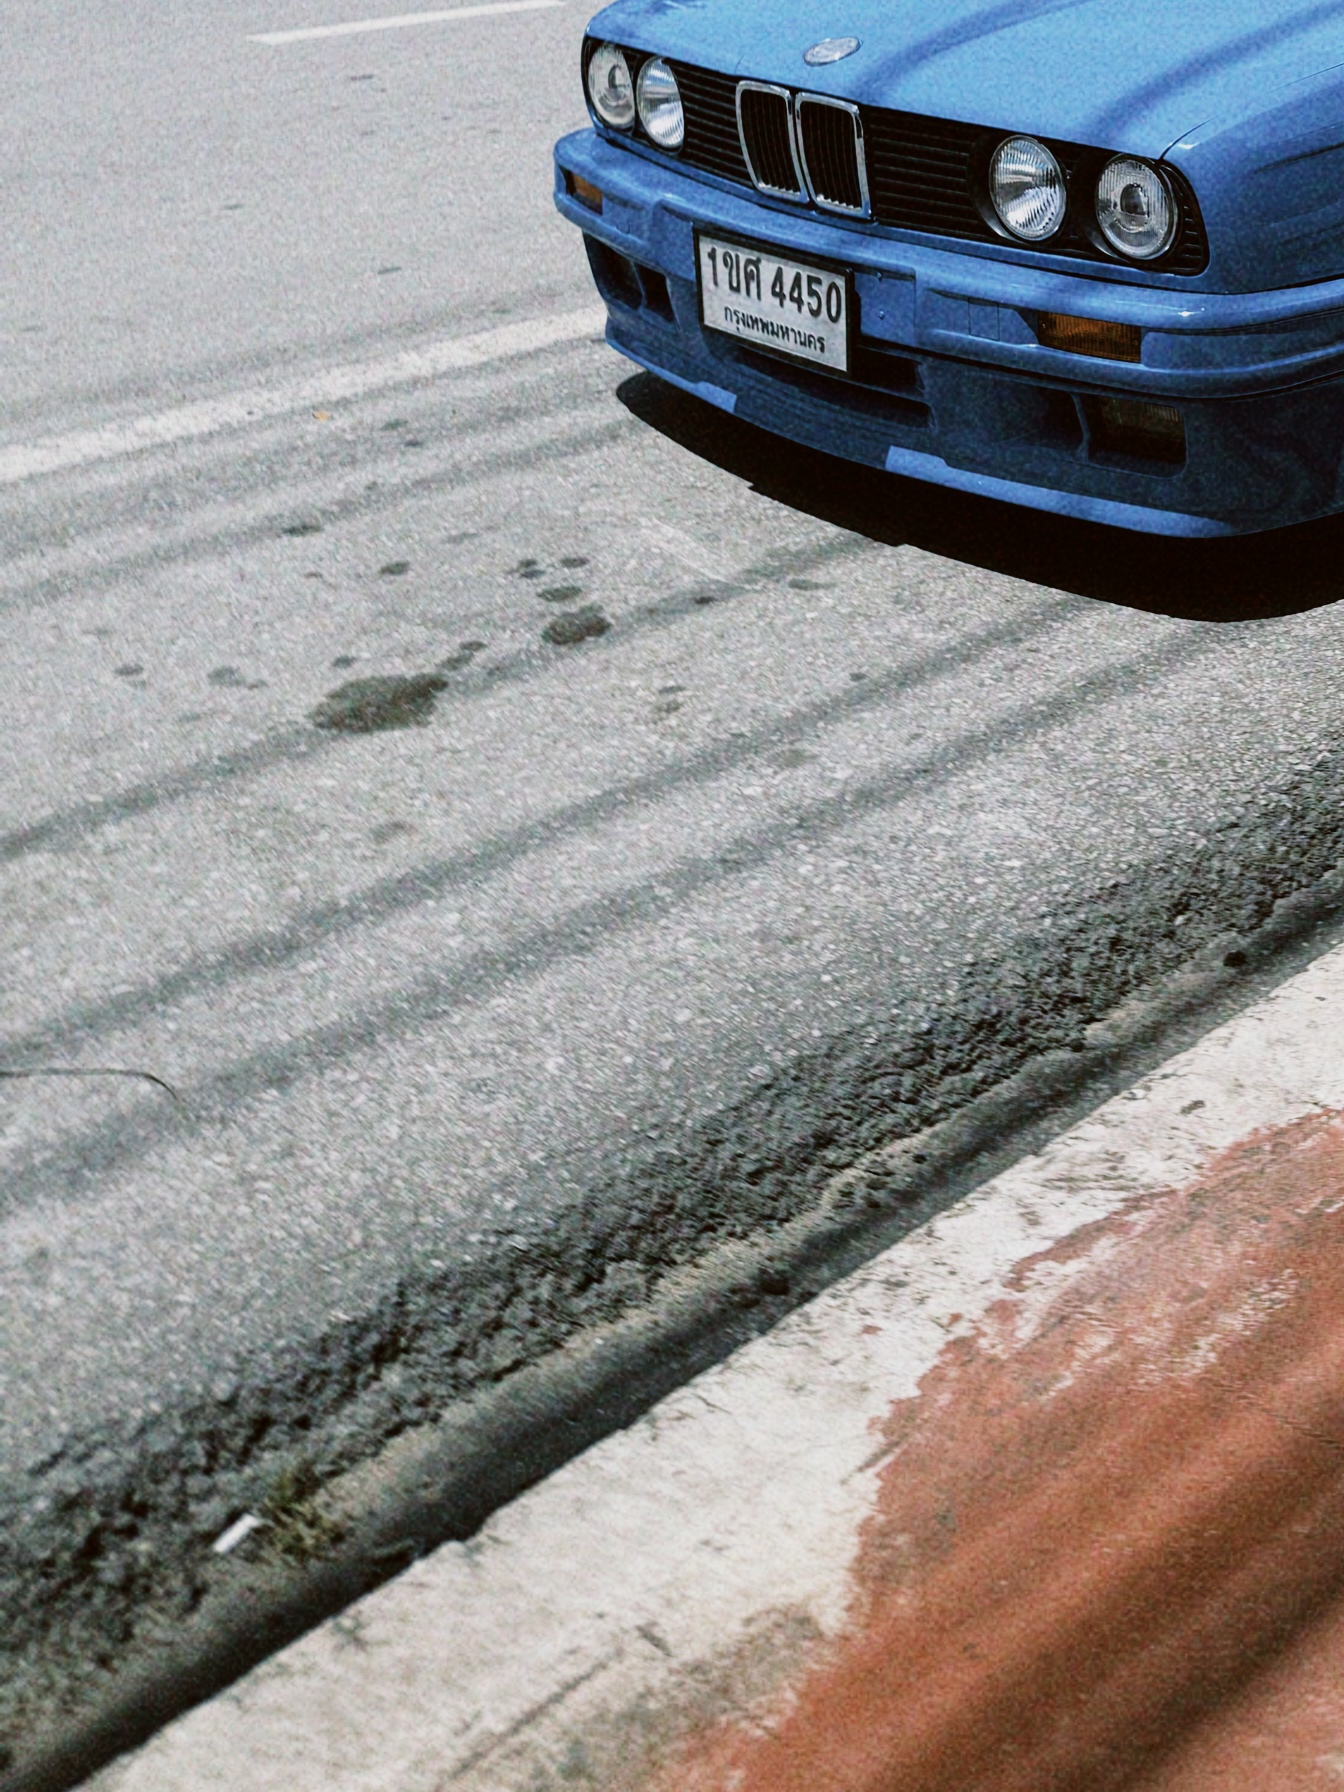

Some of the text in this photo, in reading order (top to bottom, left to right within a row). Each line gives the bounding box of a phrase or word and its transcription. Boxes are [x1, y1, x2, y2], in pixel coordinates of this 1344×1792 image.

[771, 266, 842, 324] 4450
[724, 305, 826, 354] กรุงเทพมหานคร
